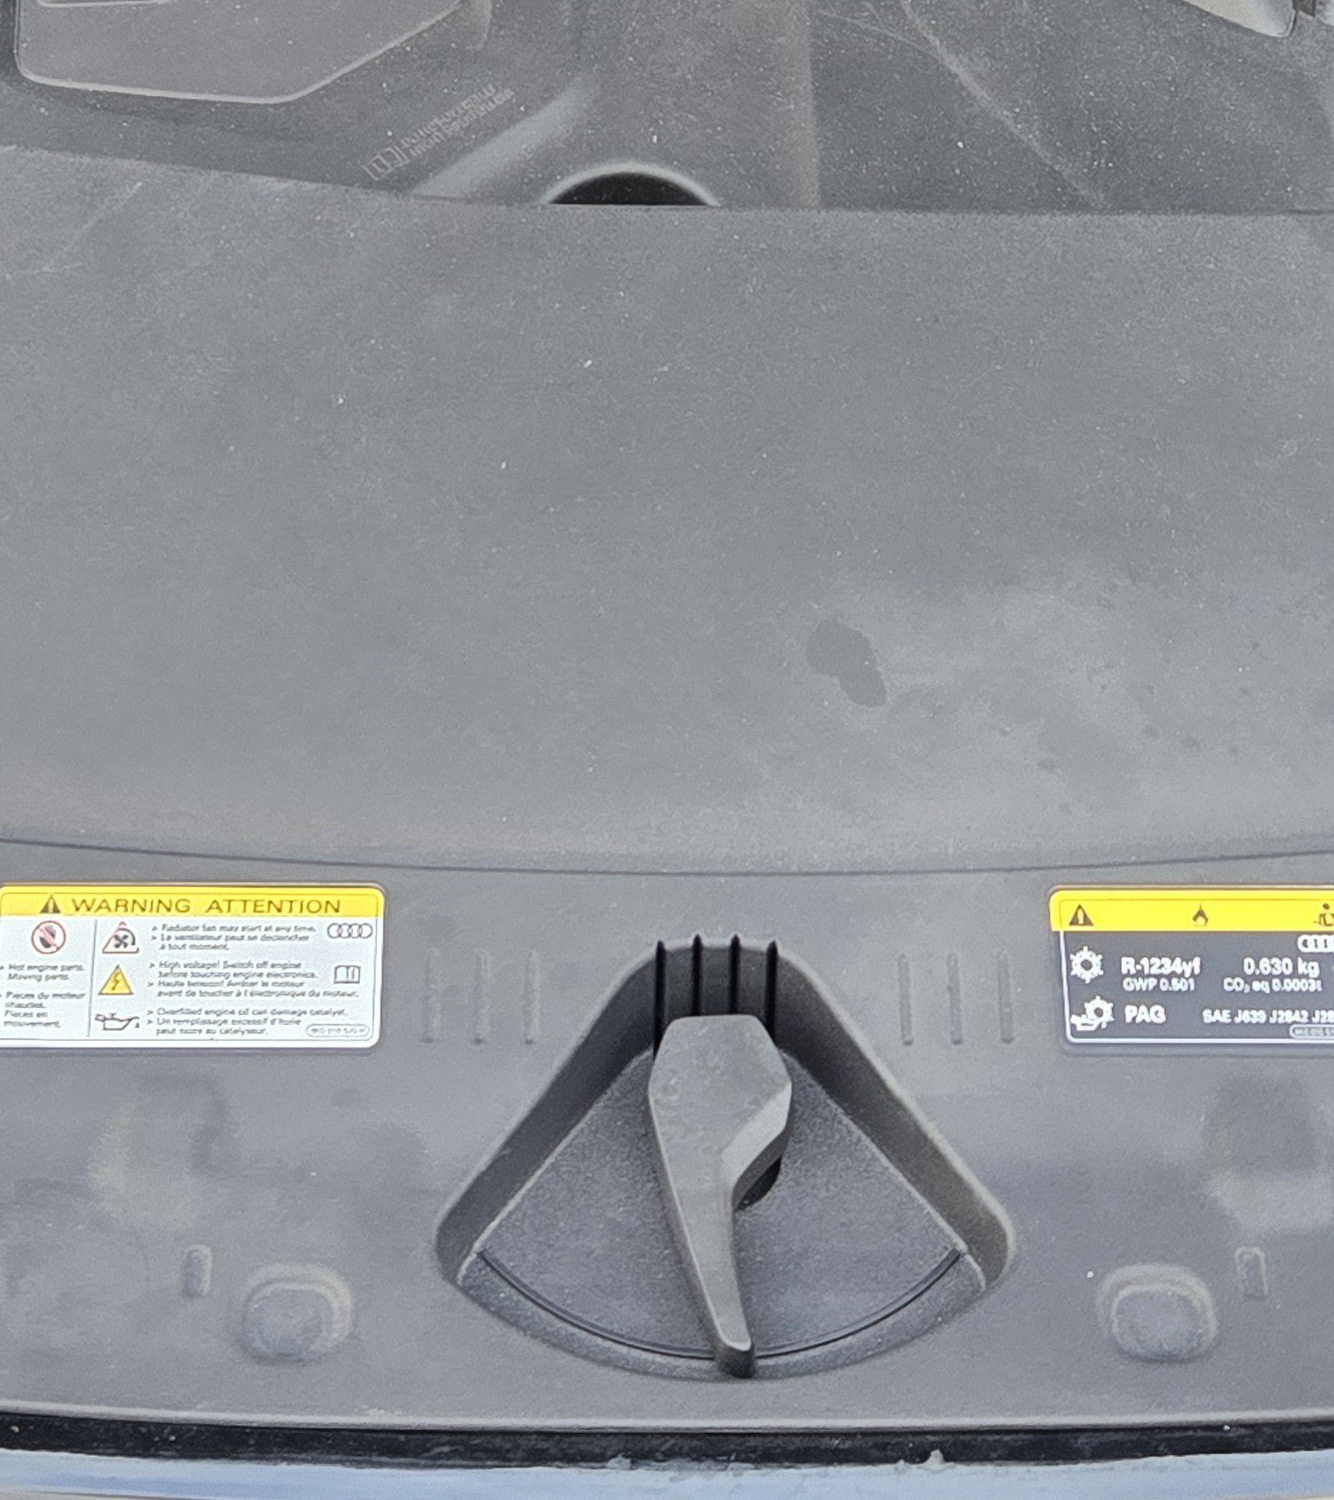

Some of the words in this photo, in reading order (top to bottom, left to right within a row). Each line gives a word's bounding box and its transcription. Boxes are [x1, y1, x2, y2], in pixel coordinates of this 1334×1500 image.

[72, 899, 191, 914] WARNING
[207, 899, 341, 914] ATTENTION
[158, 960, 180, 970] High
[270, 962, 301, 970] engine
[1121, 956, 1201, 978] R-1234yf
[1243, 958, 1293, 976] 0.630
[1297, 956, 1320, 978] kg
[233, 971, 263, 979] engine
[1123, 978, 1157, 991] GWP
[1159, 979, 1195, 991] 0.501
[1252, 980, 1270, 994] eq
[204, 1008, 235, 1016] engine
[1124, 1005, 1167, 1024] PAG
[1202, 1010, 1231, 1023] SAE
[1234, 1010, 1266, 1023] J639
